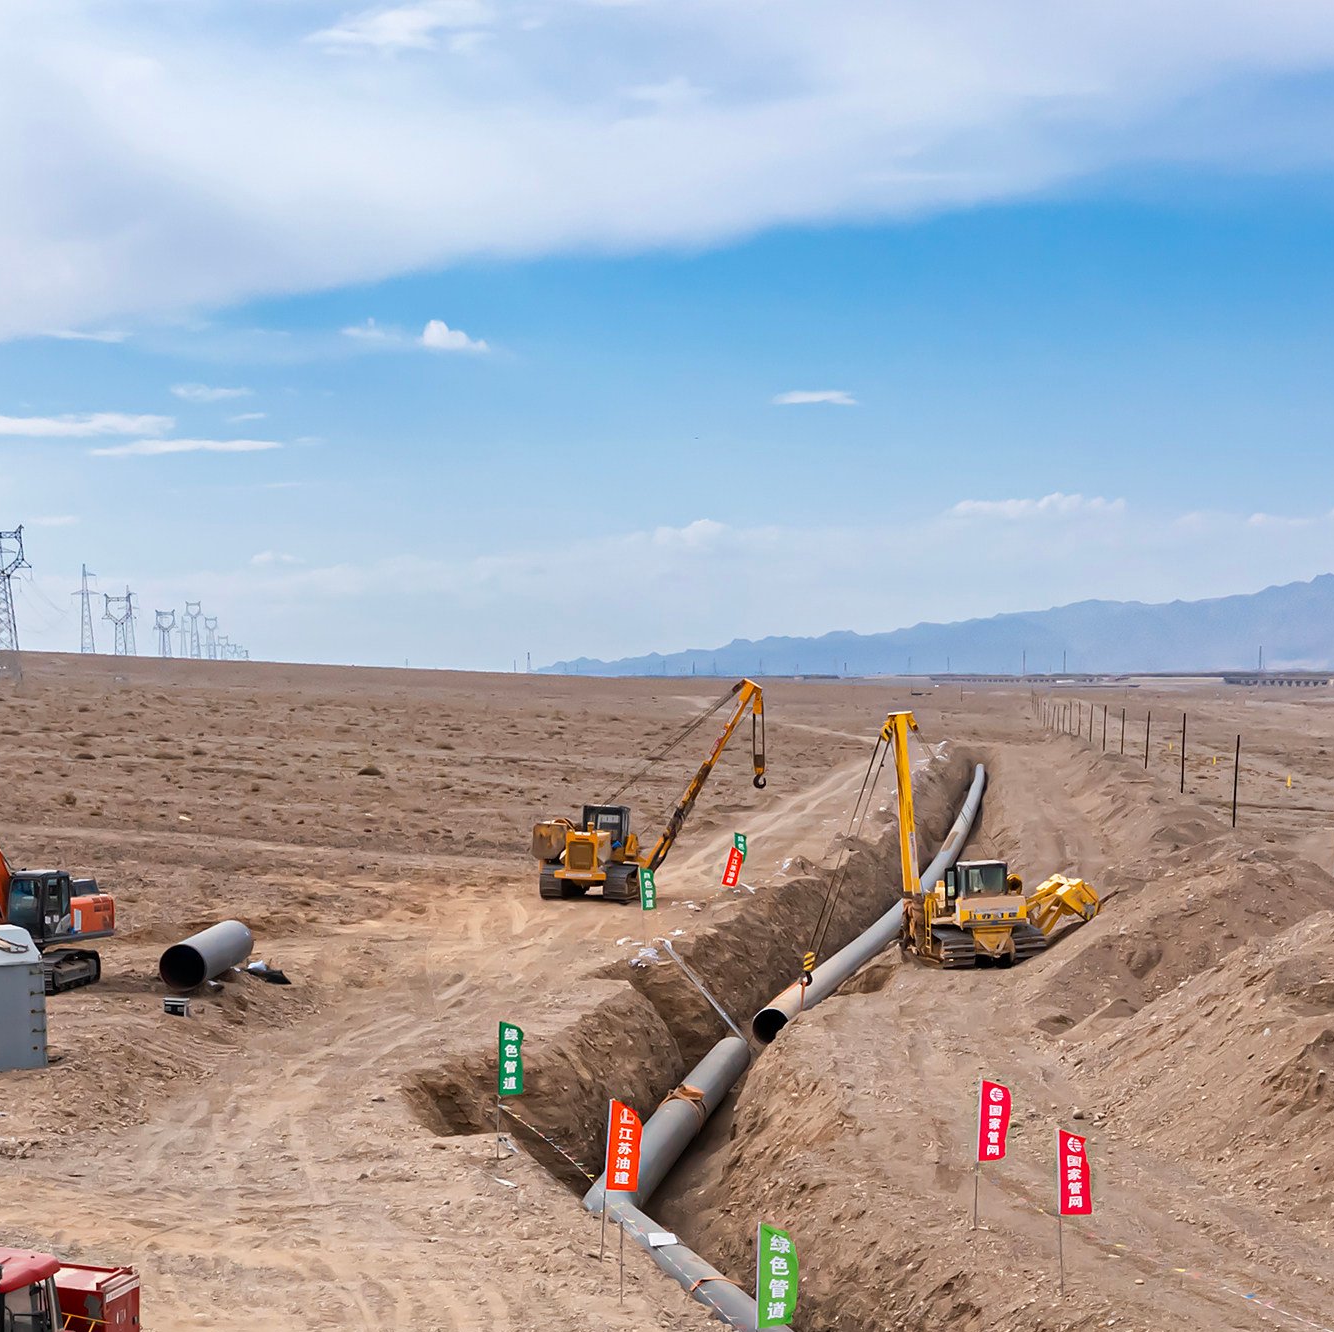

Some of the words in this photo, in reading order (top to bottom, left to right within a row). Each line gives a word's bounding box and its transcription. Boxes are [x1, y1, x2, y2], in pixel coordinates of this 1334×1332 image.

[503, 1027, 518, 1089] 绿色管道
[614, 1127, 633, 1184] 江苏油建
[987, 1104, 1002, 1156] 国家管网
[1067, 1155, 1083, 1208] 国家管网
[767, 1234, 790, 1320] 绿色管道
